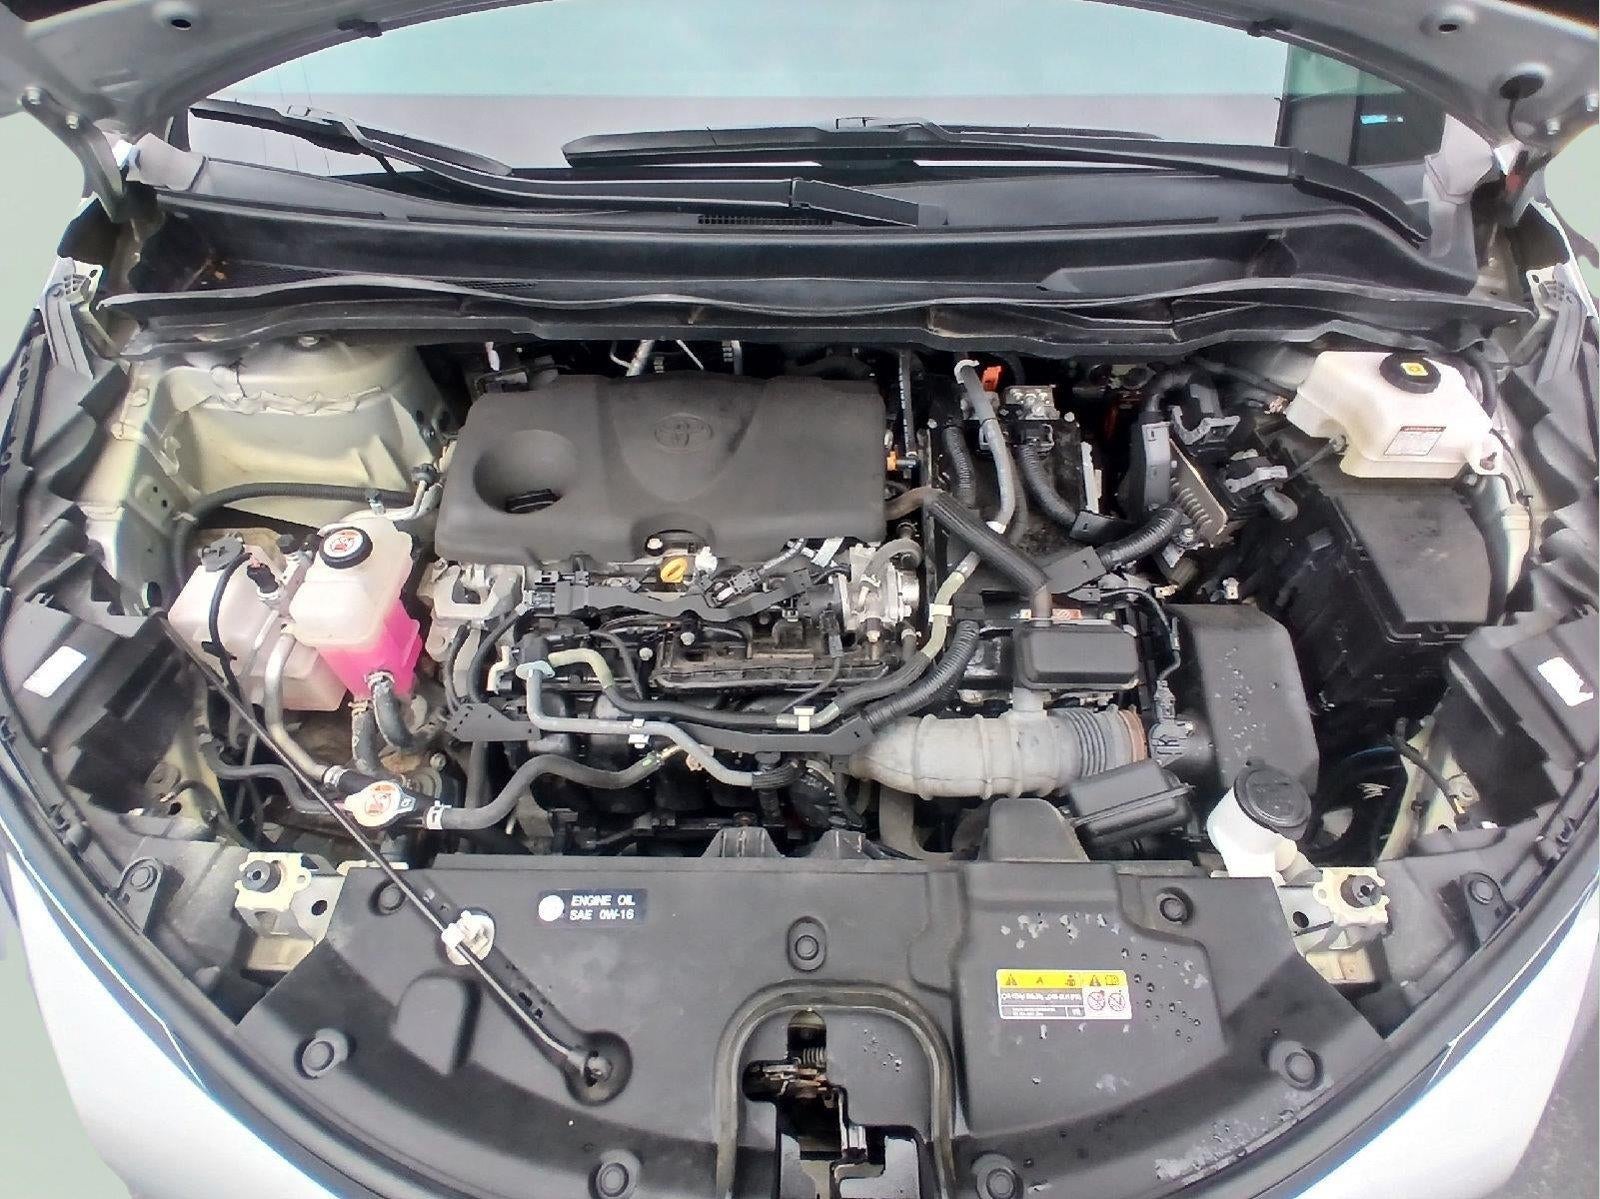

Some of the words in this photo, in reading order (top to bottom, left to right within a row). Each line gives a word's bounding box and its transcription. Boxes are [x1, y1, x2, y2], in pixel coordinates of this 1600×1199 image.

[571, 895, 612, 906] ENGINE
[618, 895, 635, 906] OIL
[570, 909, 593, 920] SAE
[599, 909, 634, 920] 0W-16
